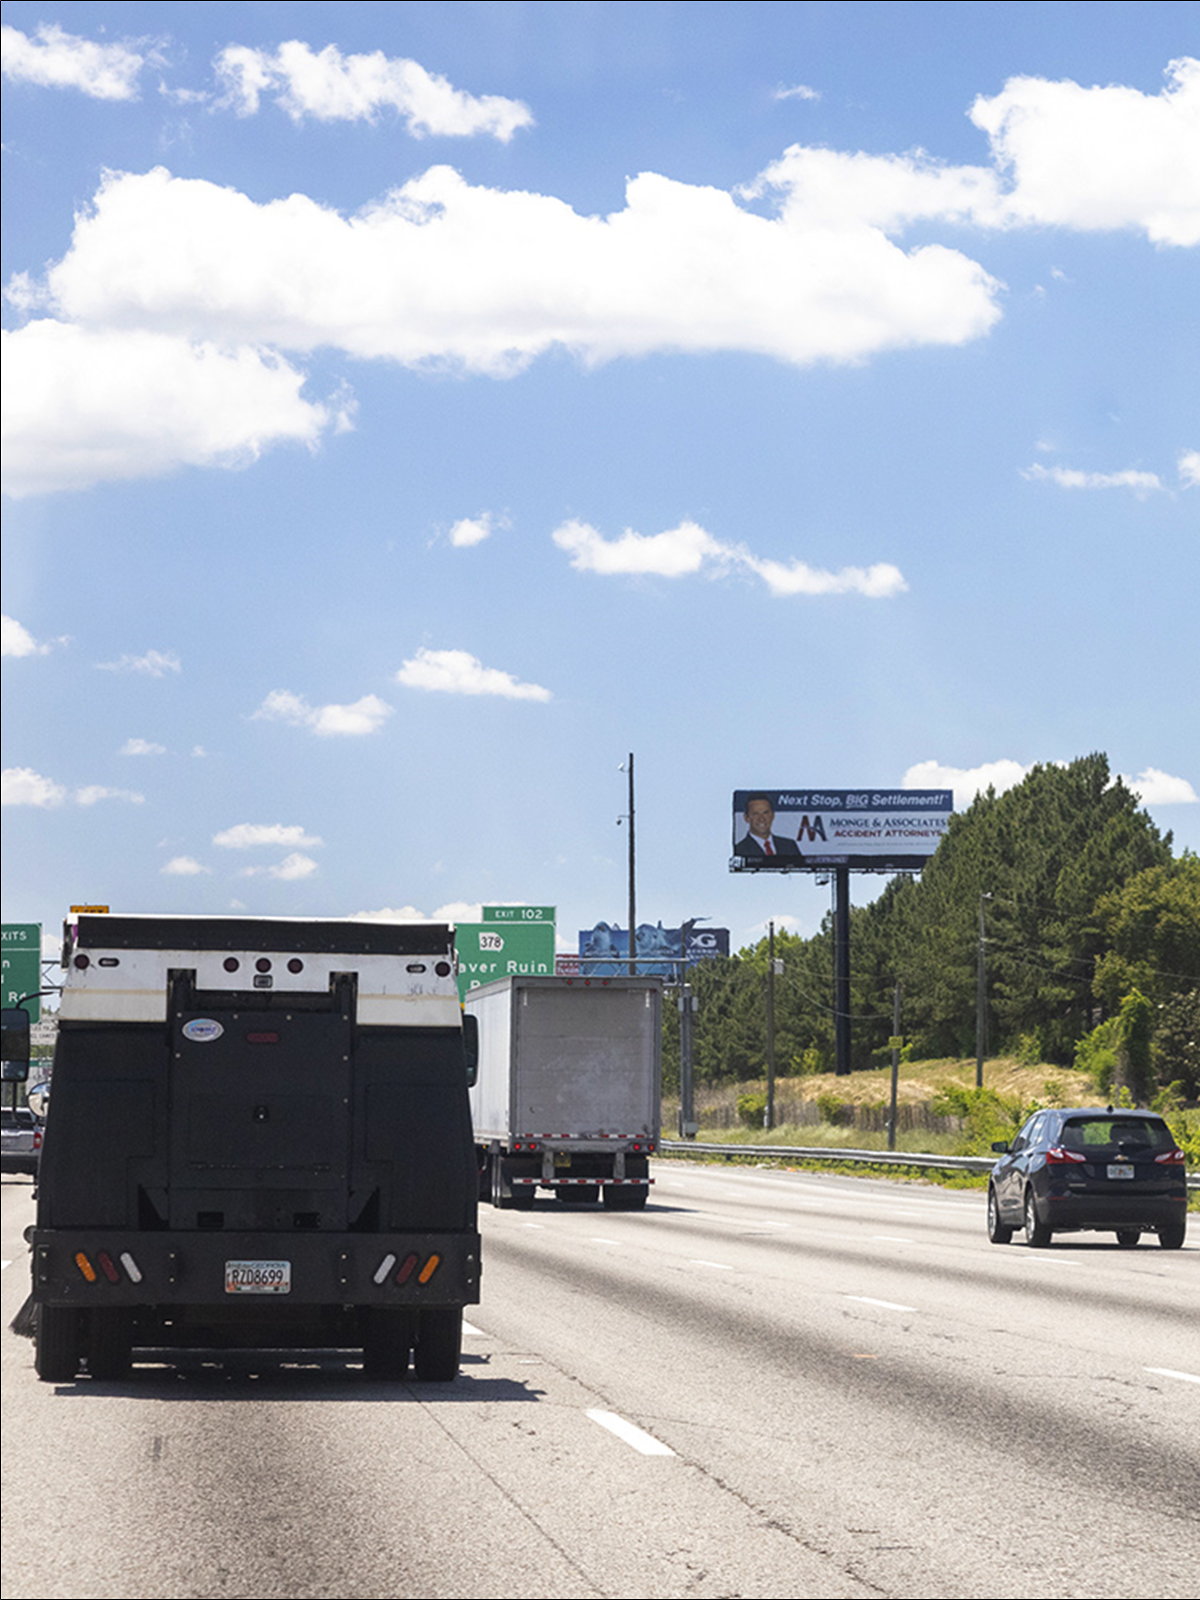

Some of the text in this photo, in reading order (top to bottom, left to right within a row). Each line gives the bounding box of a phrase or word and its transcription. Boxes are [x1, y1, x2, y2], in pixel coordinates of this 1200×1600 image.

[778, 793, 944, 808] Next Stop, BIG Settlement!
[829, 817, 947, 828] MONGE & ASSOCIATES
[833, 829, 941, 838] ACCIDENT ATTORNEYS
[495, 909, 543, 919] EXIT 102
[1, 930, 27, 941] XITS
[480, 936, 502, 948] 378
[459, 962, 497, 973] aver
[507, 960, 548, 973] Ruin
